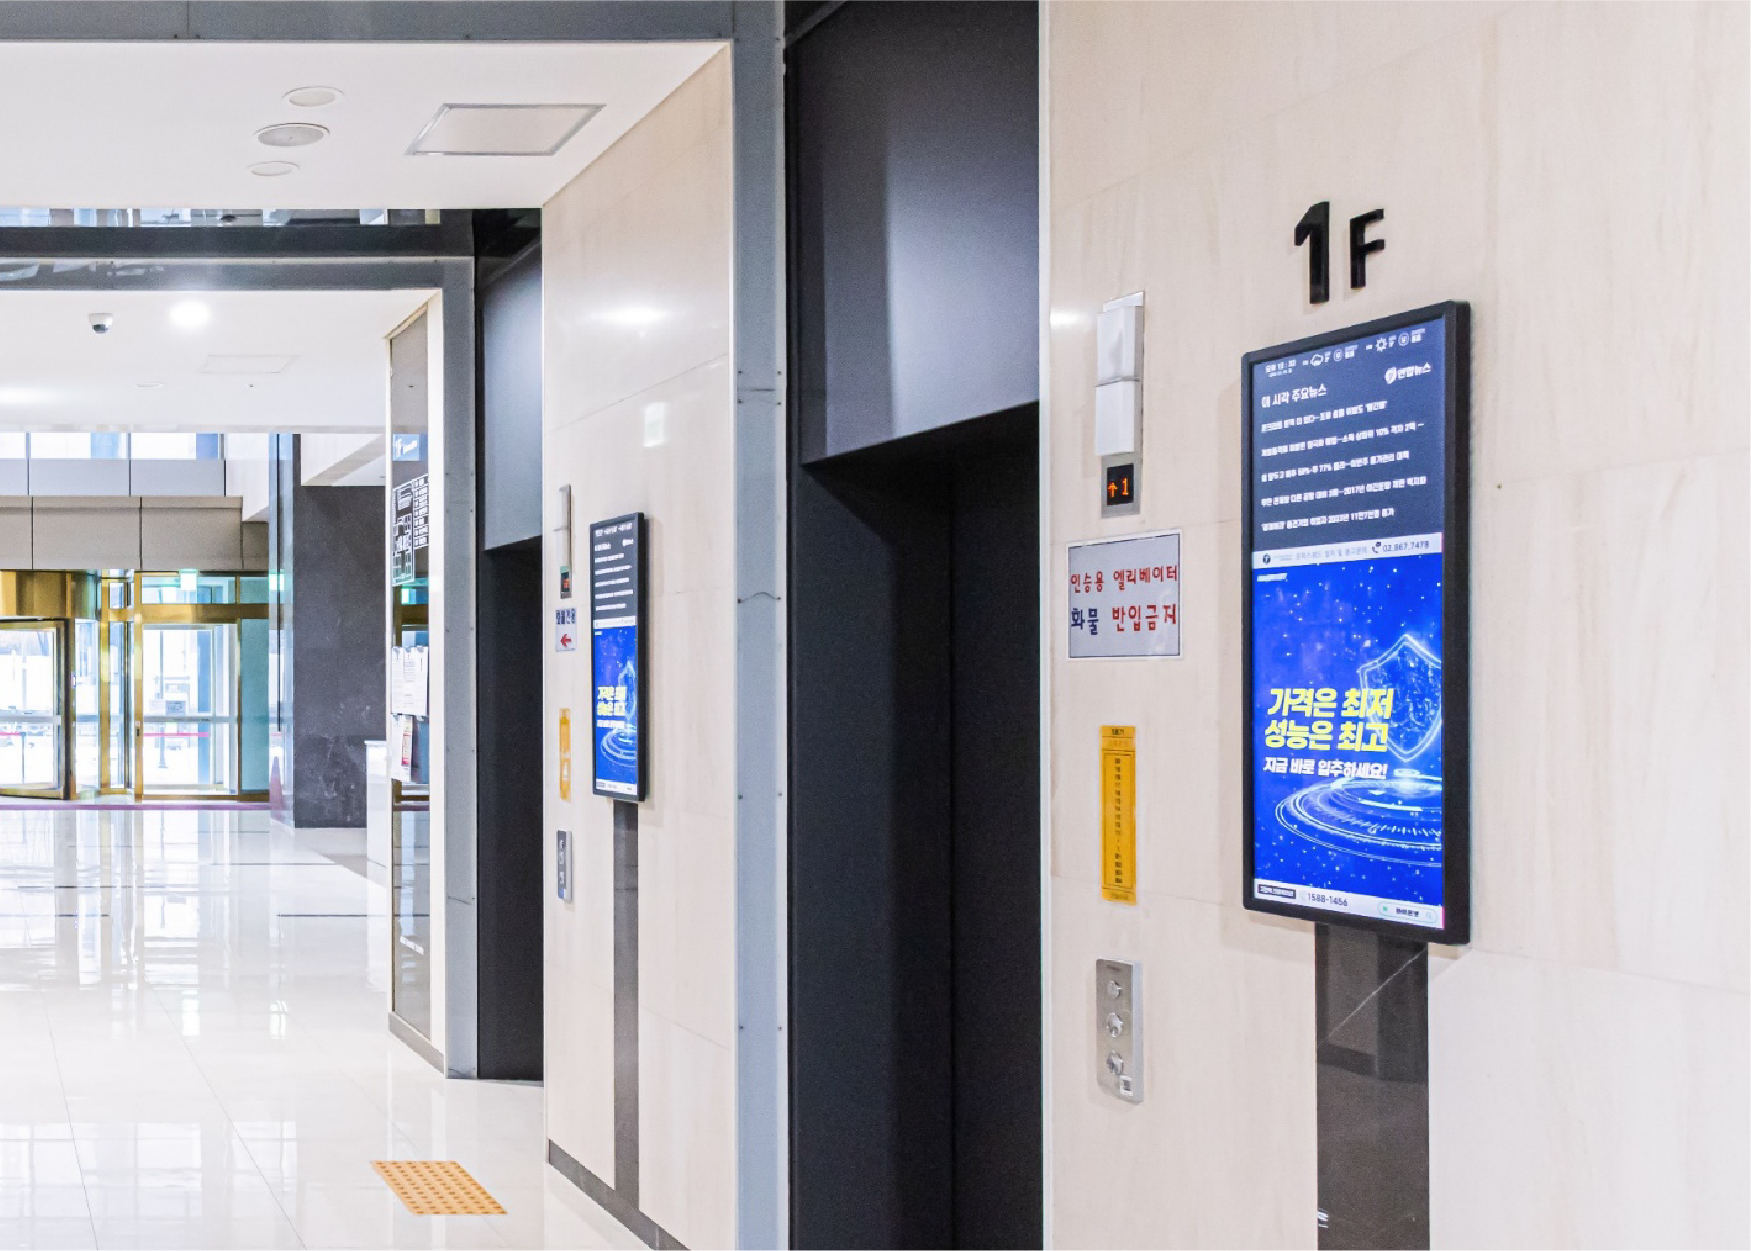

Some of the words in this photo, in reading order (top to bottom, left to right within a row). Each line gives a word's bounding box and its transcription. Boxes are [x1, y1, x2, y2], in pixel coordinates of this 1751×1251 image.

[1293, 201, 1385, 290] 1F
[1272, 391, 1290, 406] 시각
[1291, 383, 1327, 403] 주요뉴스
[1121, 477, 1130, 496] 1
[1070, 571, 1105, 594] 인승용
[1112, 565, 1178, 591] 엘리베이터
[1070, 607, 1100, 636] 화물
[1111, 603, 1177, 632] 반입금지
[1267, 687, 1338, 718] 가격은
[1340, 687, 1394, 720] 최저
[1264, 719, 1334, 752] 성능은
[1337, 720, 1389, 753] 최고
[1262, 756, 1289, 774] 지금
[1290, 757, 1315, 775] 바로
[1307, 893, 1348, 907] 1588-1456
